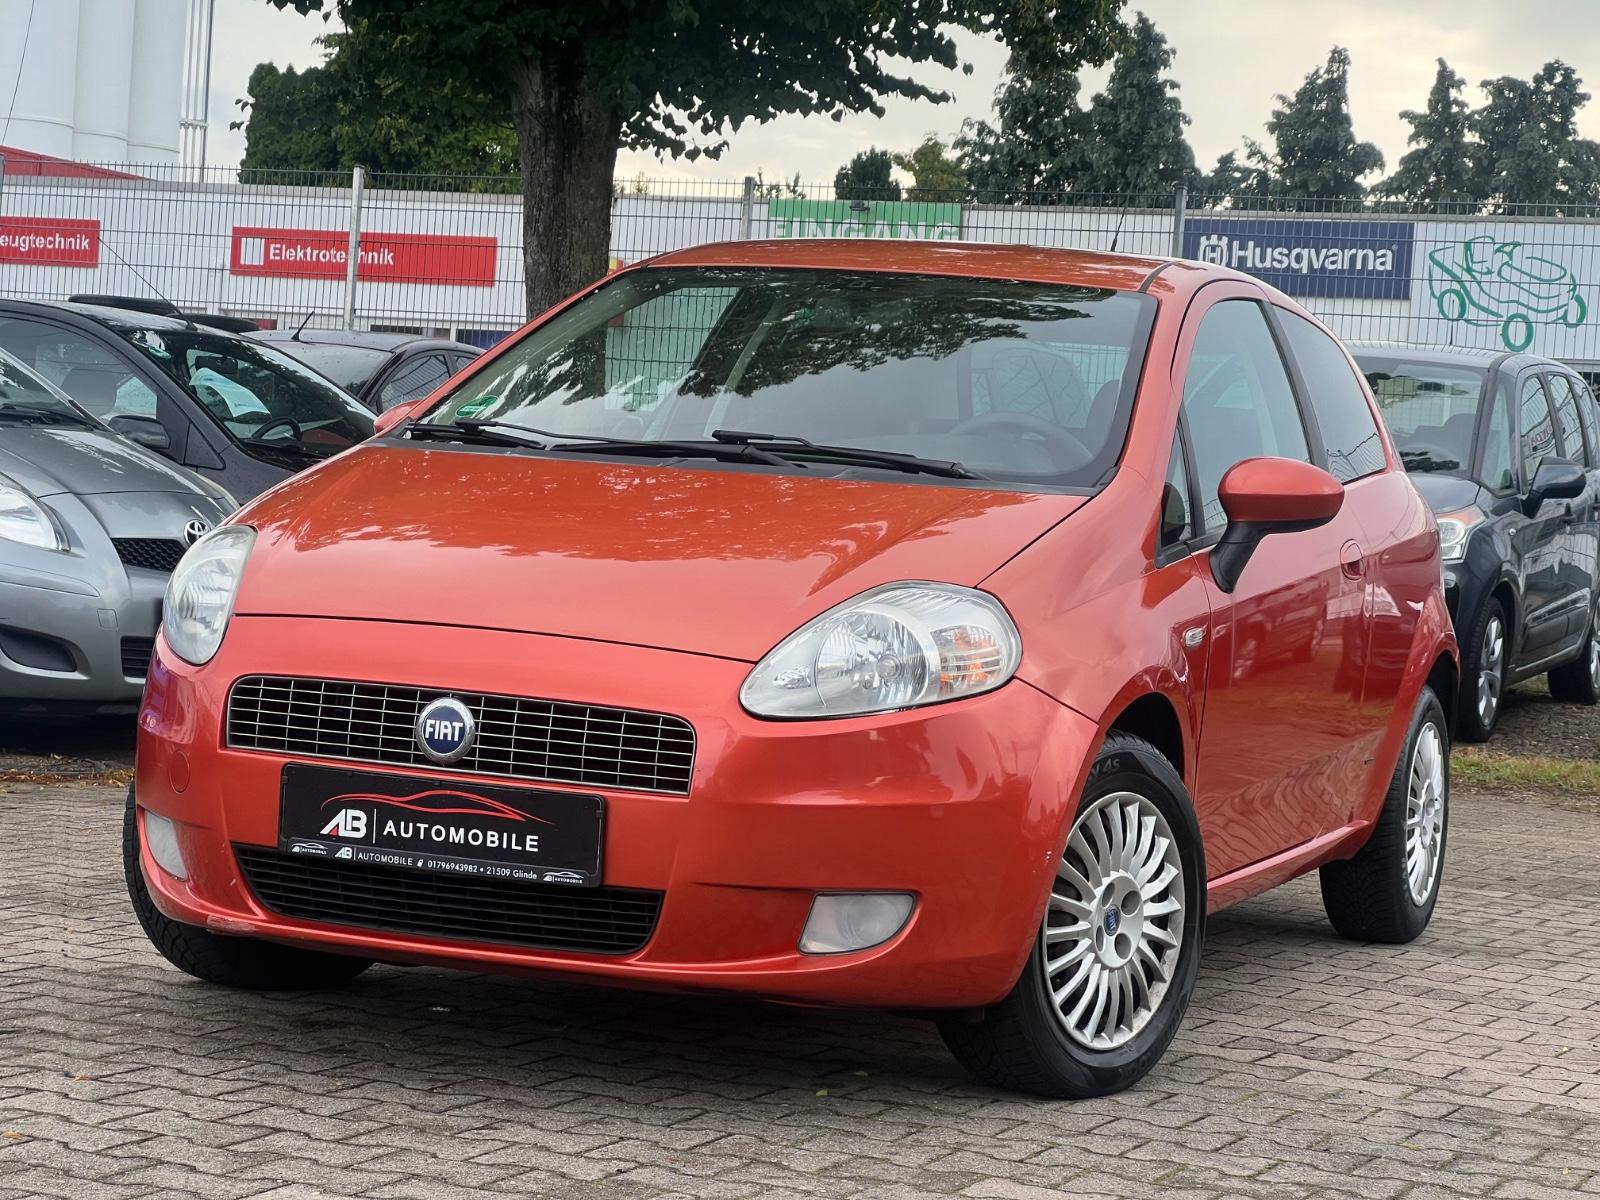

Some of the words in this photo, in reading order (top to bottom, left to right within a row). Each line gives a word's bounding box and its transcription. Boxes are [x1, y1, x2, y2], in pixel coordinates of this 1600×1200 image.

[0, 232, 90, 252] eugtechnik
[269, 243, 394, 265] Elektrotehnik
[1232, 240, 1393, 274] Husqvarna
[425, 719, 464, 742] FIAT
[320, 808, 367, 839] AB
[383, 819, 539, 852] AUTOMOBILE
[335, 847, 353, 859] AB
[358, 852, 413, 866] AUTOMOBILE
[427, 860, 478, 873] 01796943982
[486, 866, 511, 877] 21509
[513, 869, 537, 880] Glinde
